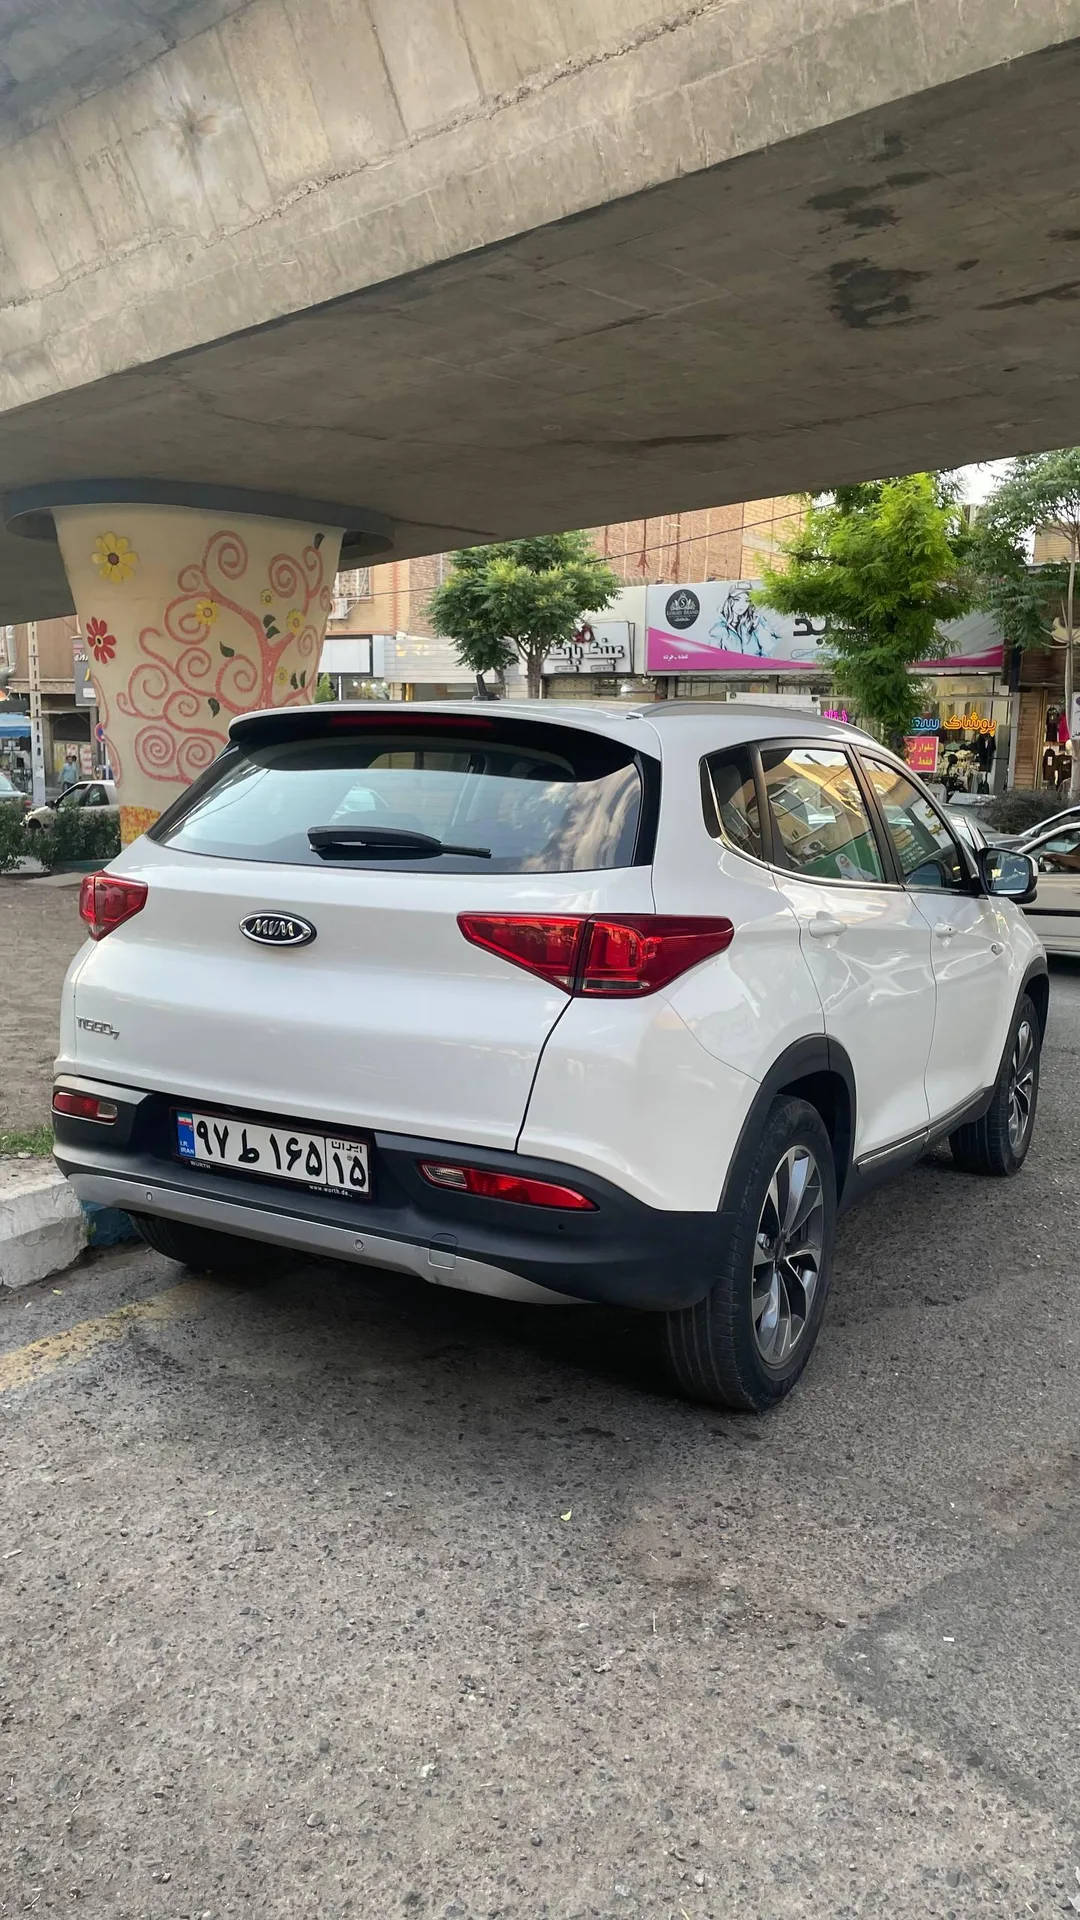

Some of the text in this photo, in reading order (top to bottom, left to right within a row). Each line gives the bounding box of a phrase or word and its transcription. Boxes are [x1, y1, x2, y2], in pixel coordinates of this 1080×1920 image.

[583, 637, 625, 665] عینک
[944, 712, 997, 738] پوشاک
[918, 756, 933, 766] فقط
[250, 918, 295, 937] MVM
[179, 1146, 195, 1155] IRAN
[331, 1140, 363, 1154] ایران
[332, 1152, 367, 1188] ۱۵
